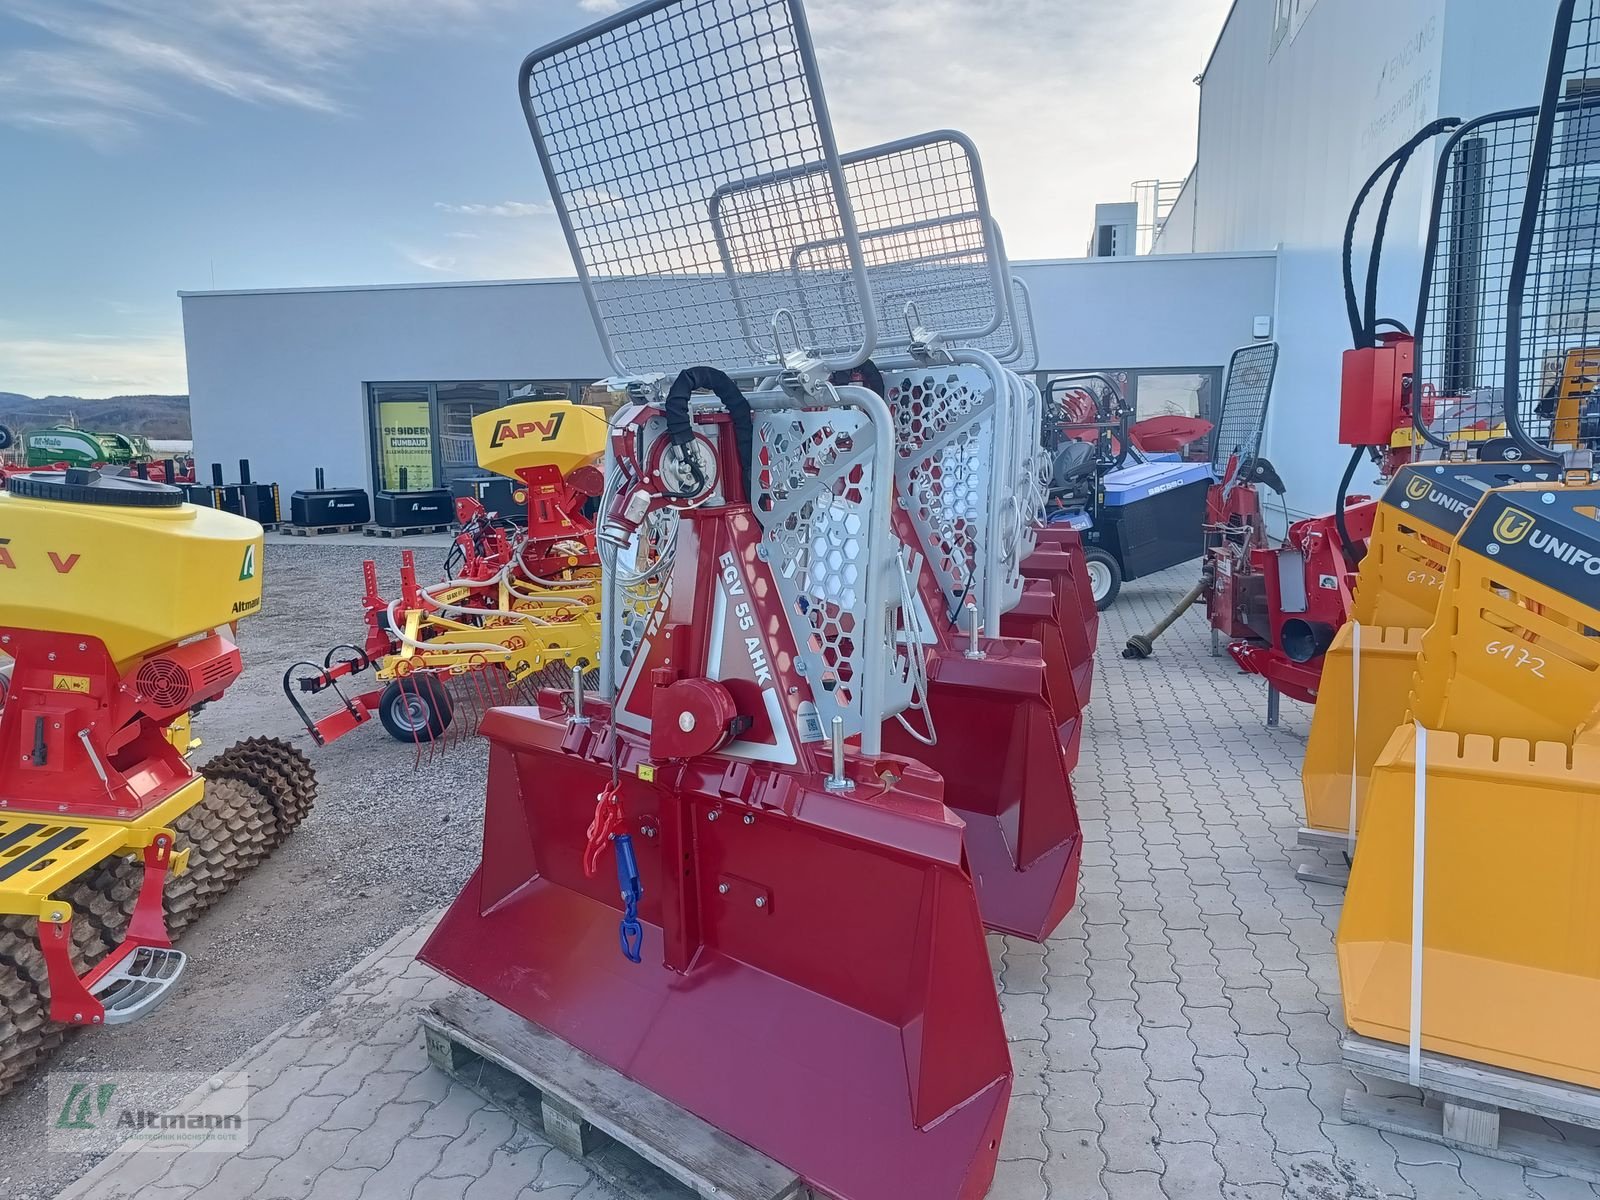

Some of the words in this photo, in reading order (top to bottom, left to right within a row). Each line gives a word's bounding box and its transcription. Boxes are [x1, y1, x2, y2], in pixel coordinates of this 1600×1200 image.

[391, 439, 427, 447] HUMBAUR
[499, 419, 554, 441] APV
[718, 551, 745, 597] EGV
[735, 602, 754, 631] 55
[744, 637, 772, 687] AHK
[1485, 641, 1546, 679] 6172
